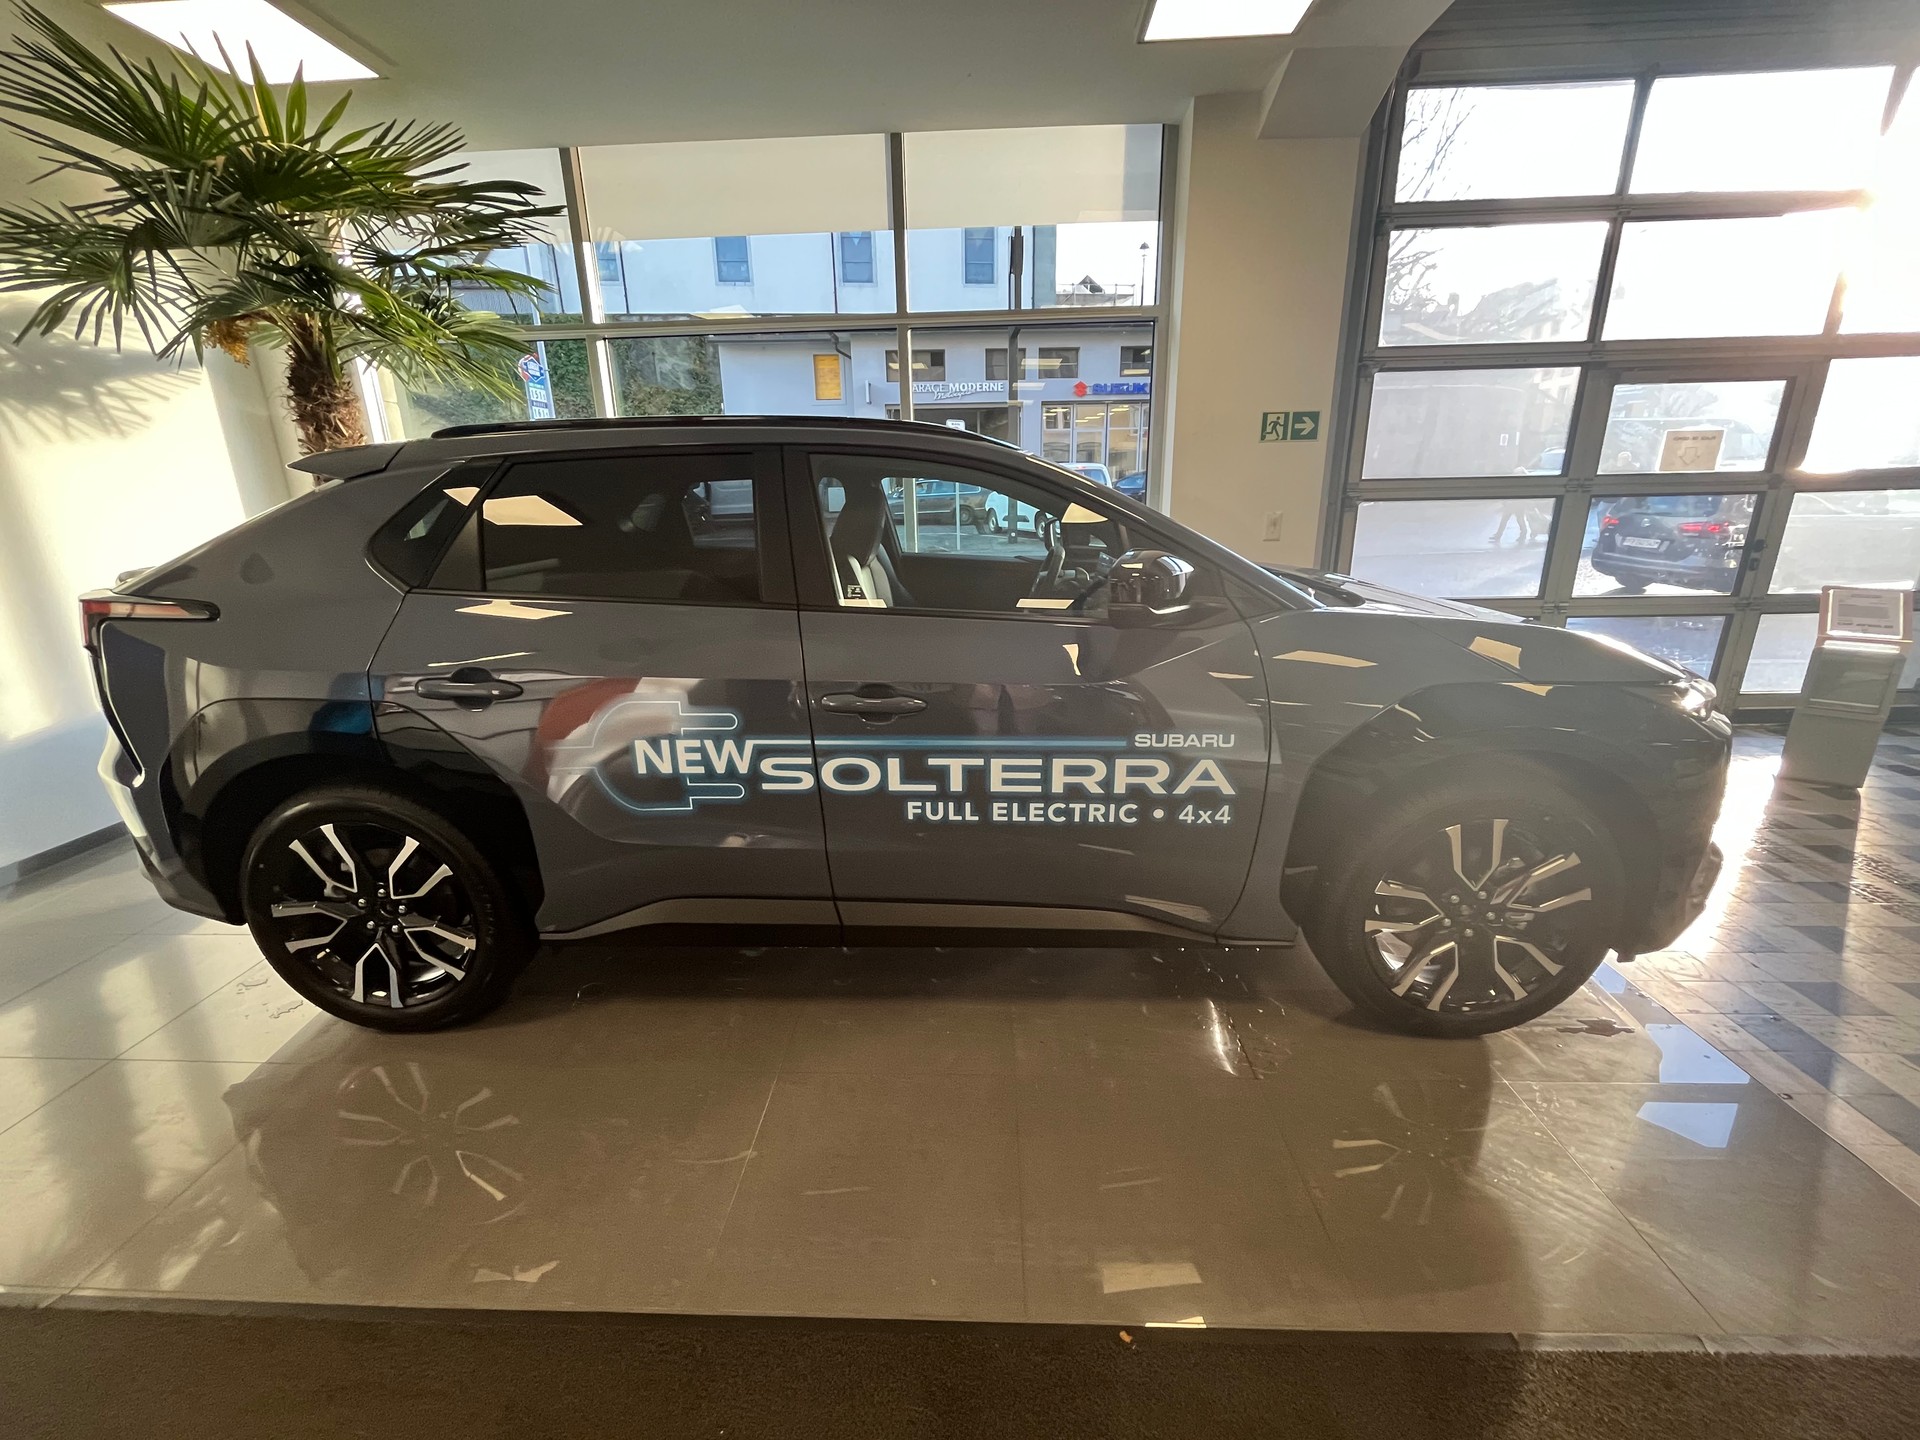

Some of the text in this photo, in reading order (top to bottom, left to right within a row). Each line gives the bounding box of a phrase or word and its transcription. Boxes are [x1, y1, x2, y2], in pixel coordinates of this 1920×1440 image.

[912, 382, 1004, 392] ARAGE MODERNE
[1092, 382, 1149, 395] SUZUK
[1134, 733, 1236, 748] SUBARU
[634, 739, 1236, 795] NEW SOLTERRA
[907, 801, 1232, 825] FULL ELECTRIC 4x4
